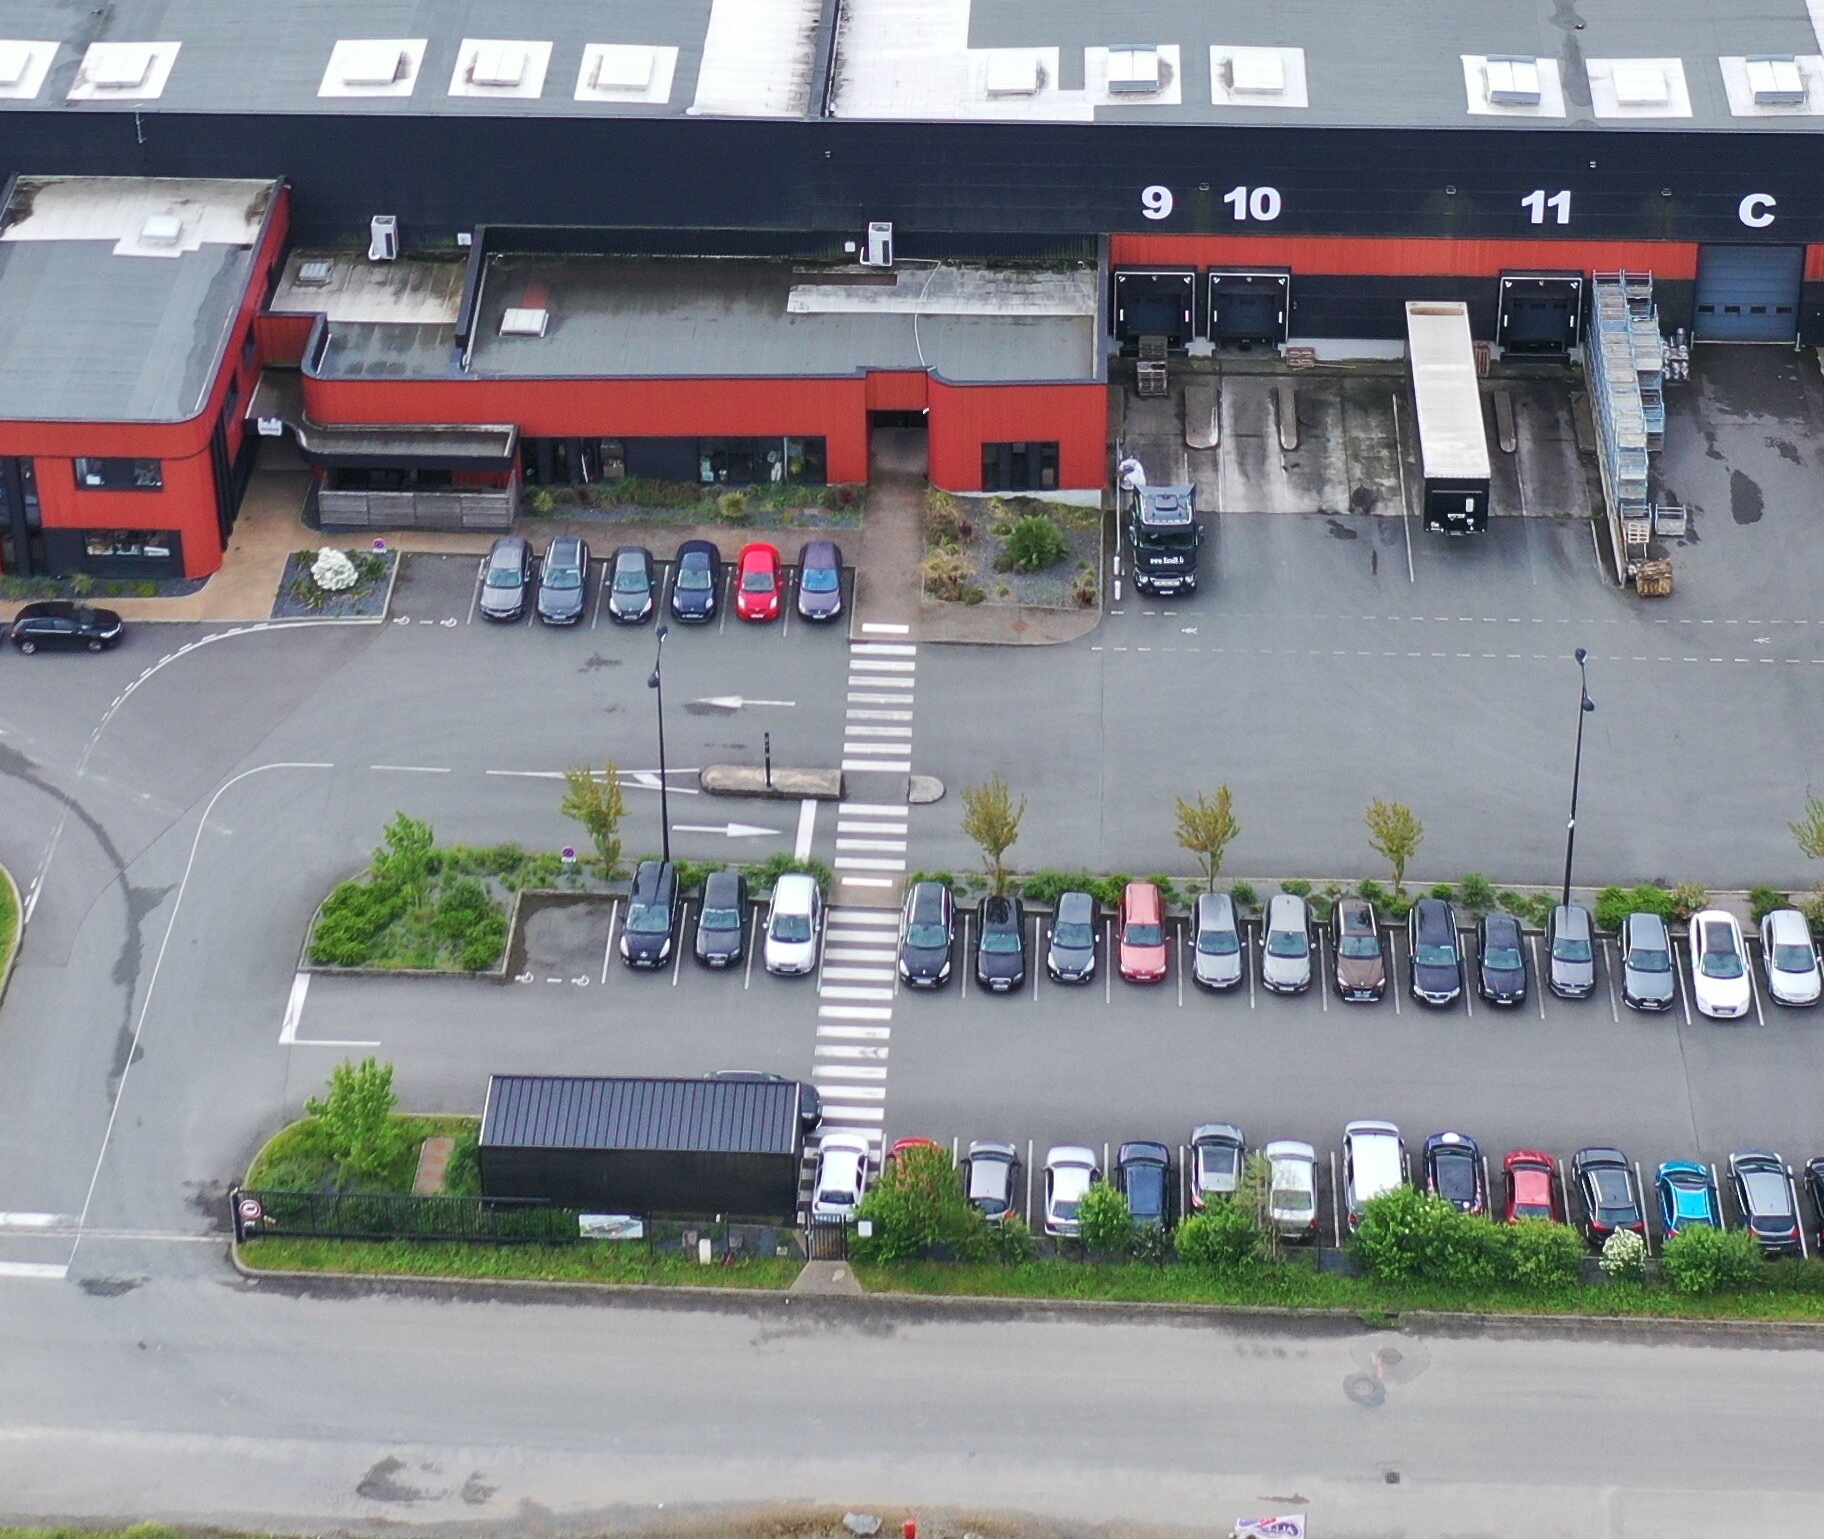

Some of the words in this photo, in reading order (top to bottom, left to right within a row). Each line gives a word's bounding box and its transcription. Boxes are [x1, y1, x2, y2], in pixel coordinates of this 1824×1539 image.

[1141, 185, 1173, 220] 9
[1223, 186, 1282, 221] 10
[1521, 189, 1571, 224] 11
[1738, 193, 1777, 228] C
